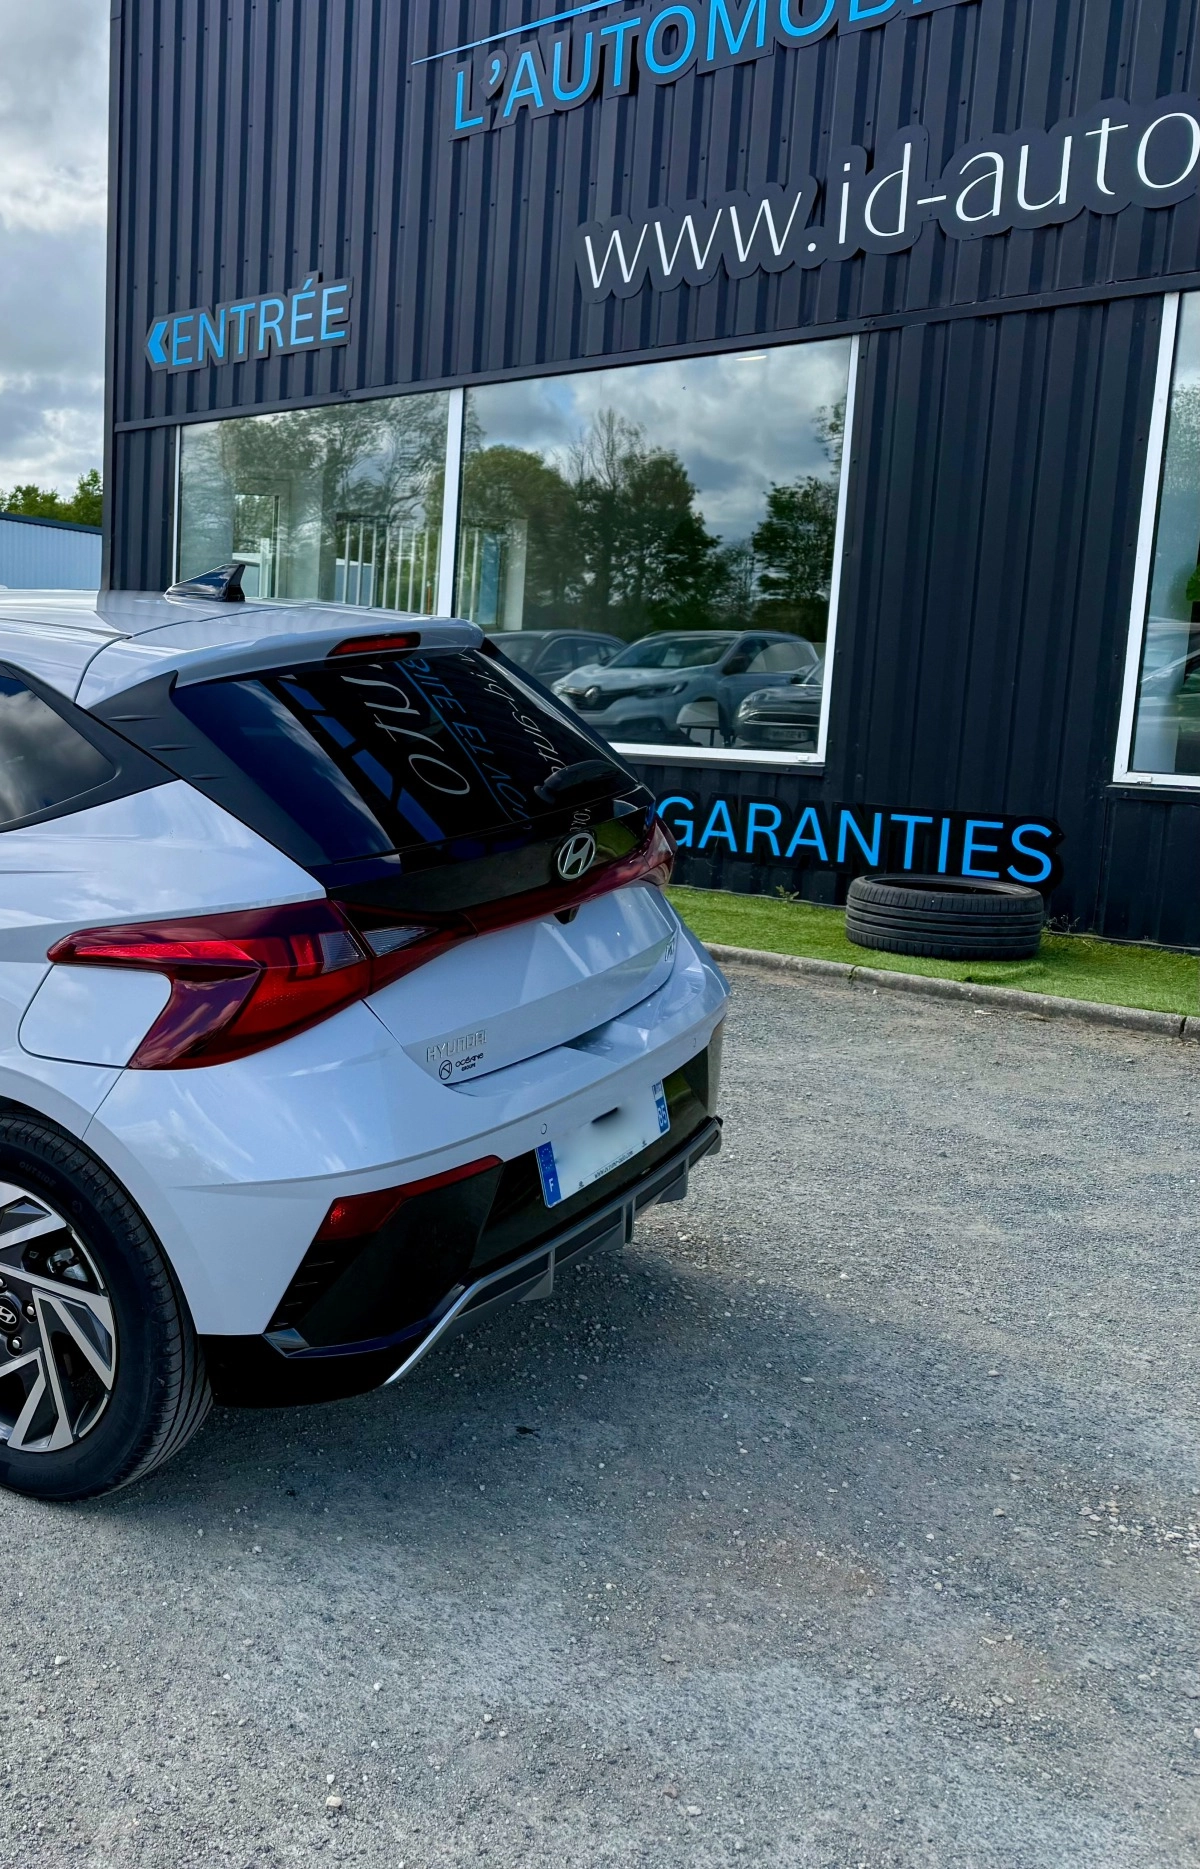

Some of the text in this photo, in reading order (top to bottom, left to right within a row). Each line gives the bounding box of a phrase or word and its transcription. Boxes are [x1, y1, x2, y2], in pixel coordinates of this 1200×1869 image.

[584, 112, 1200, 290] www.id-auto
[172, 278, 348, 366] ENTRÉE
[656, 796, 1053, 883] GARANTIES
[426, 1029, 488, 1063] HYUNDAI
[548, 1177, 554, 1192] F
